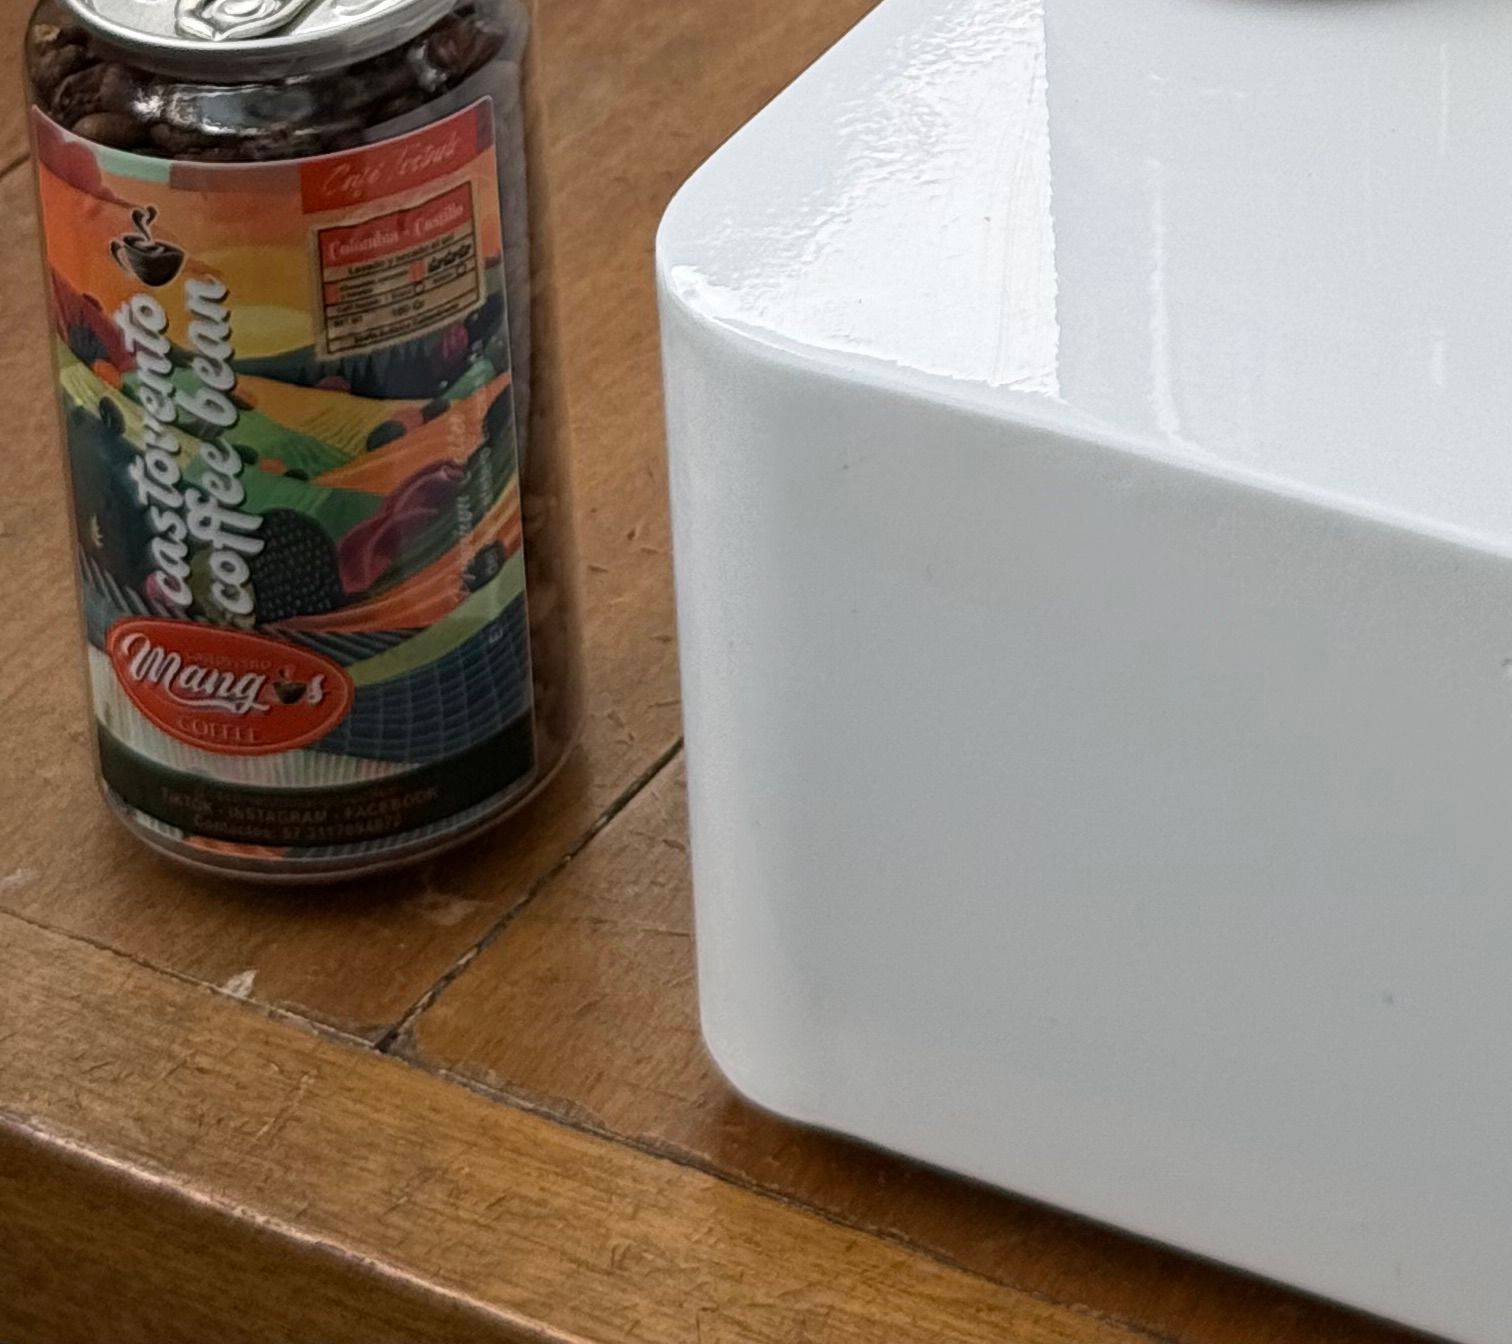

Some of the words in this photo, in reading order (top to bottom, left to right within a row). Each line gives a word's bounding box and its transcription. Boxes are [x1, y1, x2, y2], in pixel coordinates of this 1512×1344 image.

[176, 276, 238, 427] bean
[115, 293, 193, 607] castovento
[185, 438, 265, 615] coffee
